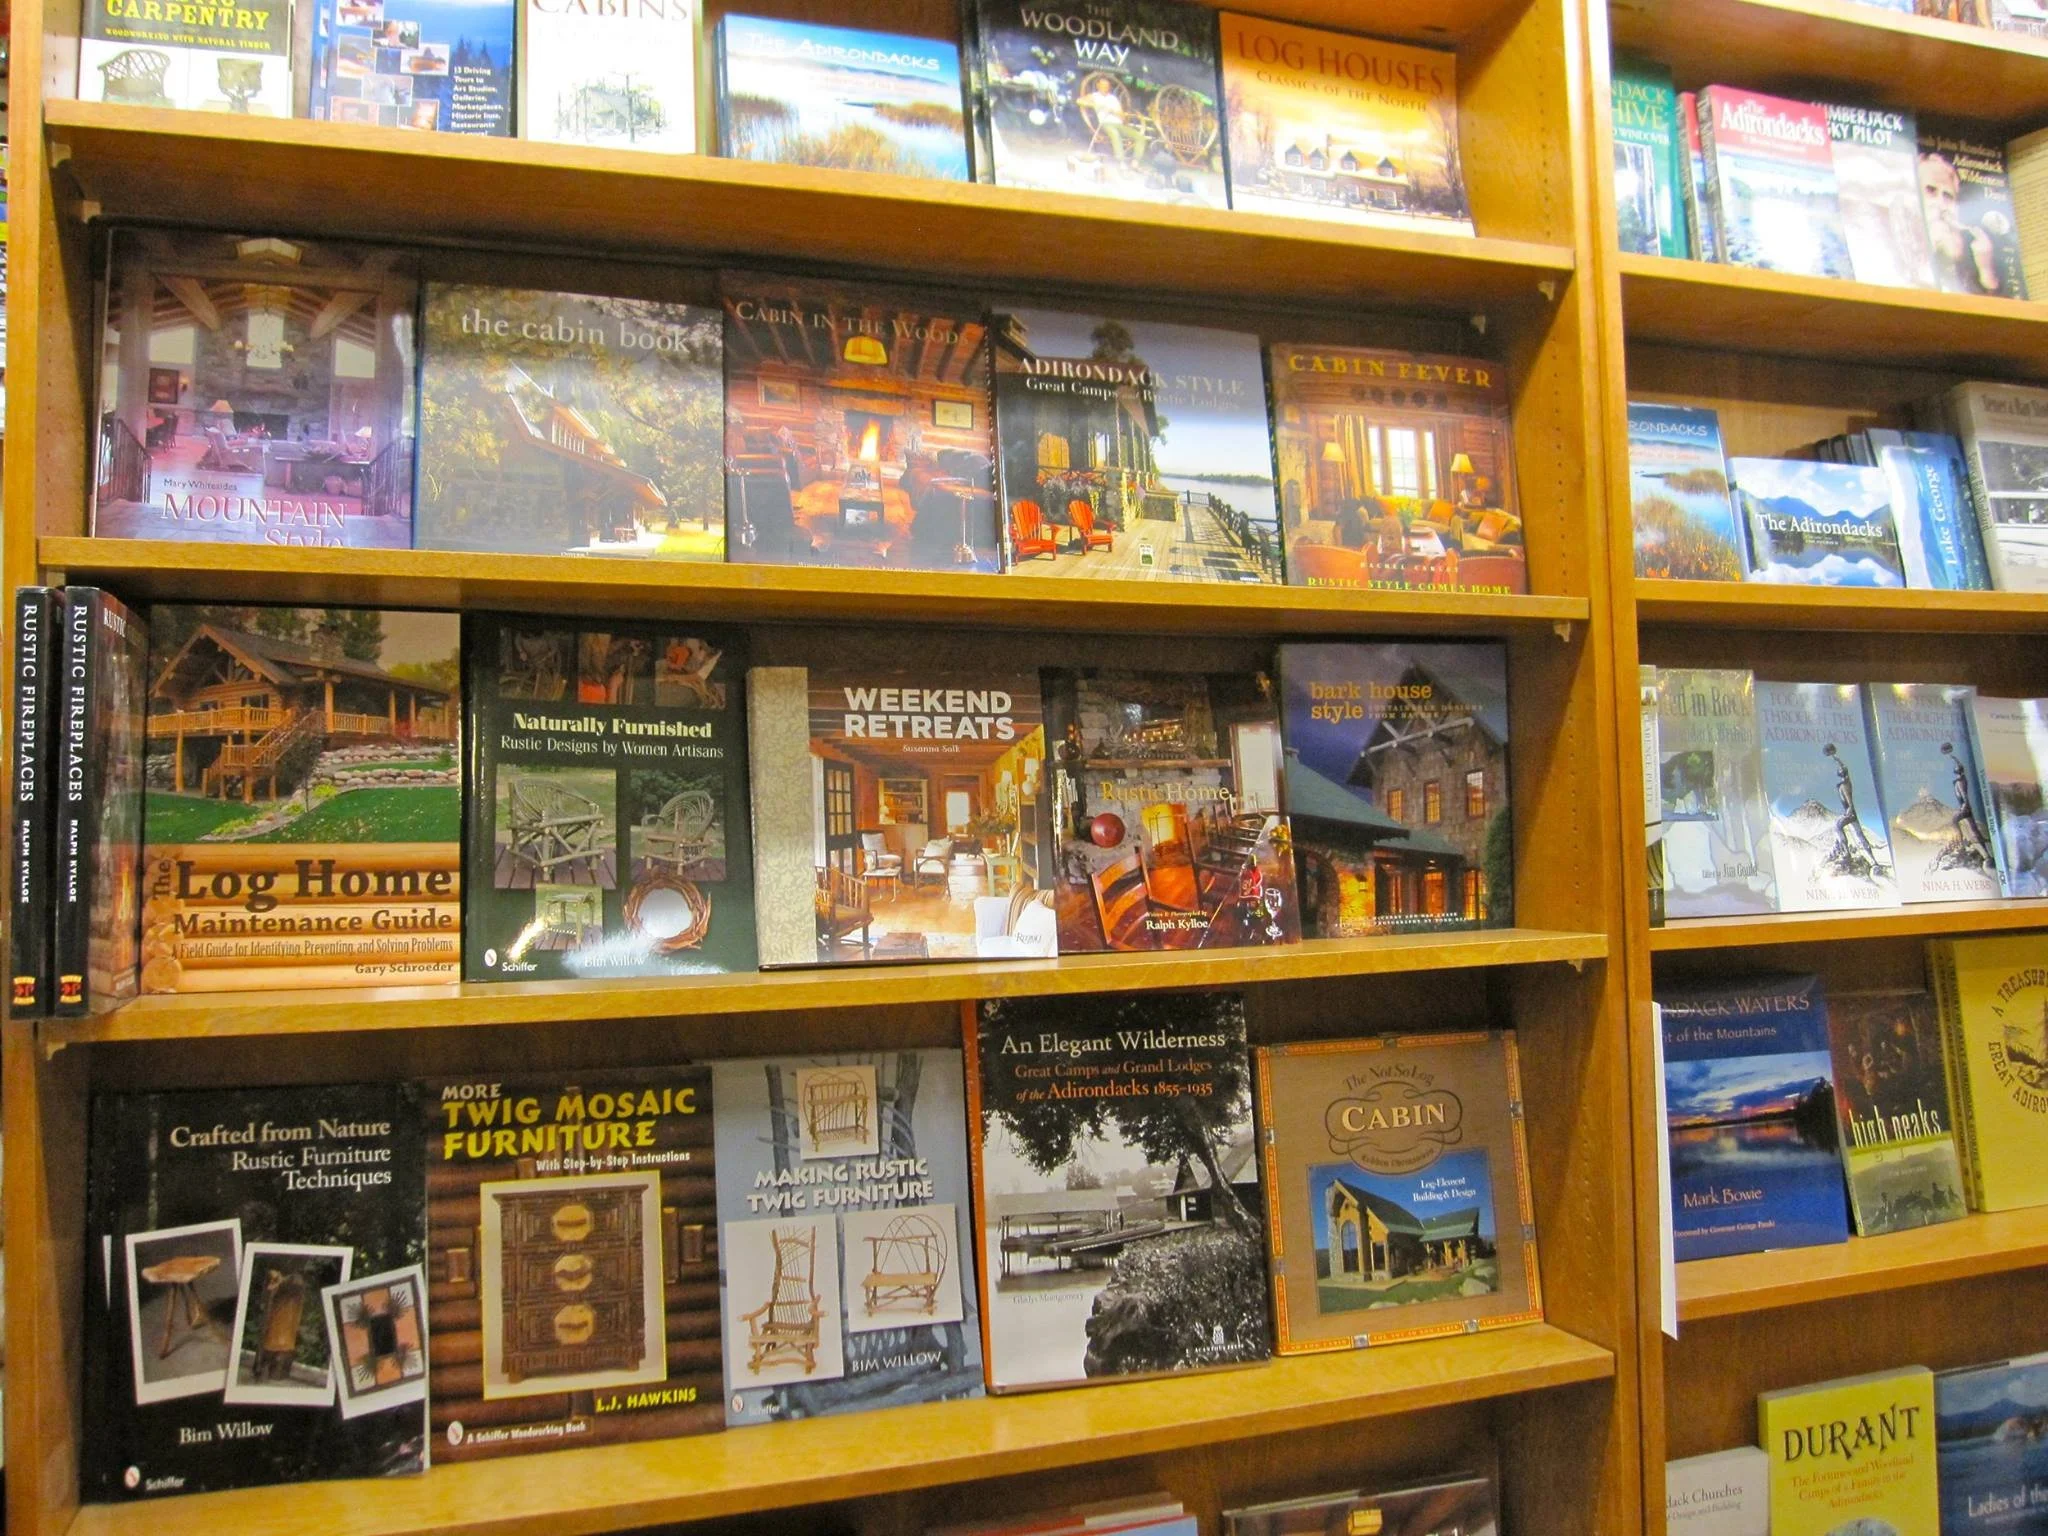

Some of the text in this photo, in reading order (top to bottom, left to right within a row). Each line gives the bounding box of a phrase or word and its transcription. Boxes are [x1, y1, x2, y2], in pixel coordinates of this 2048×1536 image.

[106, 0, 269, 31] CARPENTRY
[532, 0, 689, 22] CABINS
[1086, 4, 1111, 17] THE
[173, 34, 194, 43] WITH
[198, 36, 236, 48] NATURAL
[1021, 8, 1178, 50] WOODLAND
[746, 32, 940, 72] THE ADIRONDACKS
[1074, 38, 1130, 67] WAY
[1238, 31, 1443, 95] LOG HOUSES
[454, 75, 474, 83] Tours
[463, 66, 491, 76] Driving
[451, 112, 482, 120] Historic
[451, 121, 495, 129] Restaurants
[1721, 102, 1825, 146] Adirondacks
[1853, 125, 1893, 146] PILOT
[736, 300, 803, 325] CABIN
[461, 308, 690, 353] the cabin book
[1020, 358, 1244, 396] ADIRONDACK STYLE
[1288, 354, 1491, 388] CABIN FEVER
[1026, 378, 1118, 401] Great Camps
[1629, 420, 1708, 437] RONDACKS
[163, 478, 238, 491] Mary Whitesides
[161, 493, 347, 529] MOUNTAIN
[1925, 463, 1958, 565] Lake George
[1755, 513, 1883, 537] The Adirondacks
[264, 528, 344, 547] Style
[1307, 577, 1511, 595] RUSTIC STYLE COMES HOME
[104, 607, 127, 638] RUSTIC
[844, 687, 1012, 714] WEEKEND
[1309, 681, 1433, 700] bark house
[21, 604, 37, 802] RUSTIC FIREPLACES
[68, 604, 87, 802] RUSTIC FIREPLACES
[1311, 702, 1364, 724] style
[513, 712, 712, 738] Naturally Furnished
[844, 714, 1015, 740] RETREATS
[1765, 727, 1859, 745] ADIRONDACKS
[501, 735, 724, 759] Rustic Designs by Women Artisans
[1100, 781, 1230, 801] Rustic Home
[20, 819, 30, 904] RALPH KYLLOE
[68, 819, 79, 904] RALPH KYLLOE
[152, 860, 171, 899] The
[176, 859, 452, 913] Log Home
[1922, 880, 1949, 892] NINA
[173, 908, 452, 935] Maintenance Guide
[1146, 918, 1209, 932] Ralph Kylloe
[180, 936, 454, 959] Field Guide for and Solving Problems
[355, 961, 454, 976] Gary Schroeder
[502, 961, 538, 972] Schiffer
[615, 954, 646, 968] Willow
[1734, 994, 1810, 1014] WATERS
[1991, 1005, 2004, 1018] A
[1001, 1029, 1226, 1058] An Elegant Wilderness
[1676, 1027, 1689, 1042] of
[1693, 1028, 1713, 1041] the
[1716, 1024, 1777, 1039] Mountains
[1015, 1057, 1212, 1079] Great Camps and Grand Lodges
[1343, 1065, 1435, 1091] The Log
[442, 1083, 502, 1100] MORE
[1016, 1078, 1149, 1103] of the Adirondacks
[443, 1088, 696, 1128] TWIG MOSAIC
[1341, 1103, 1445, 1132] CABIN
[170, 1119, 390, 1147] Crafted from Nature
[443, 1121, 657, 1160] FURNITURE
[1848, 1098, 1941, 1162] high peaks
[232, 1146, 391, 1171] Rustic Furniture
[536, 1151, 690, 1171] With Step-by-Step Instructions
[282, 1169, 391, 1192] Techniques
[754, 1158, 928, 1188] MAKING RUSTIC
[747, 1180, 934, 1213] TWIG FURNITURE
[1413, 1188, 1476, 1202] Building Design
[1683, 1185, 1763, 1208] Mark Bowie
[852, 1352, 942, 1372] BIM WILLOW
[596, 1388, 697, 1413] L.J. HAWKINS
[179, 1421, 274, 1445] Bim Willow
[467, 1425, 564, 1445] A Schiffer Woodworking
[1783, 1402, 1920, 1464] DURANT
[146, 1476, 185, 1490] Schiffer
[1692, 1483, 1743, 1503] Churches
[1968, 1492, 2009, 1517] Ladies
[2013, 1484, 2026, 1508] of
